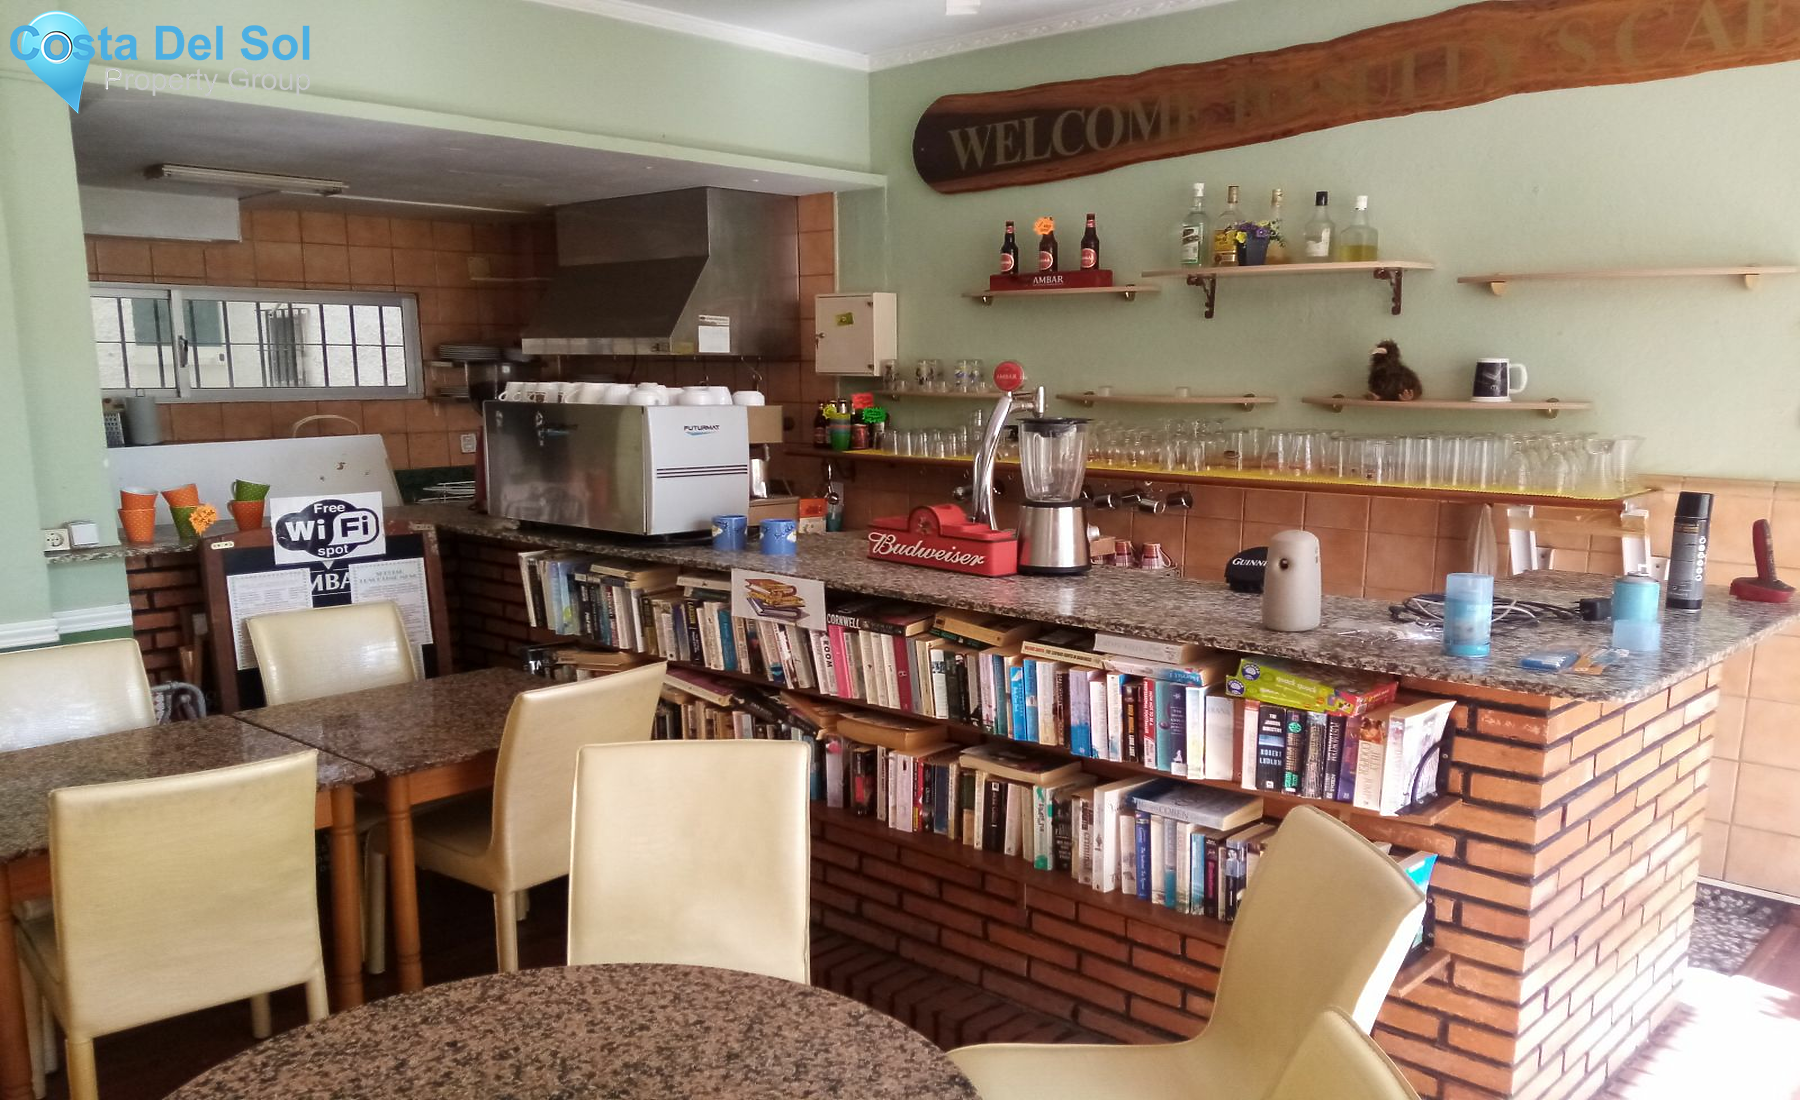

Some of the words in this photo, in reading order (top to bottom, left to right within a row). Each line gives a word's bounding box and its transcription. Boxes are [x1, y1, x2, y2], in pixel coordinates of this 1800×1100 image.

[948, 95, 1202, 171] WELCOME
[1033, 275, 1064, 284] AMBAR
[313, 503, 346, 514] Free
[285, 519, 326, 541] Wi
[340, 515, 369, 538] Fi
[317, 544, 350, 558] spot
[868, 532, 986, 567] Budweiser
[826, 613, 862, 630] CORNWELL
[823, 640, 834, 668] ROOM
